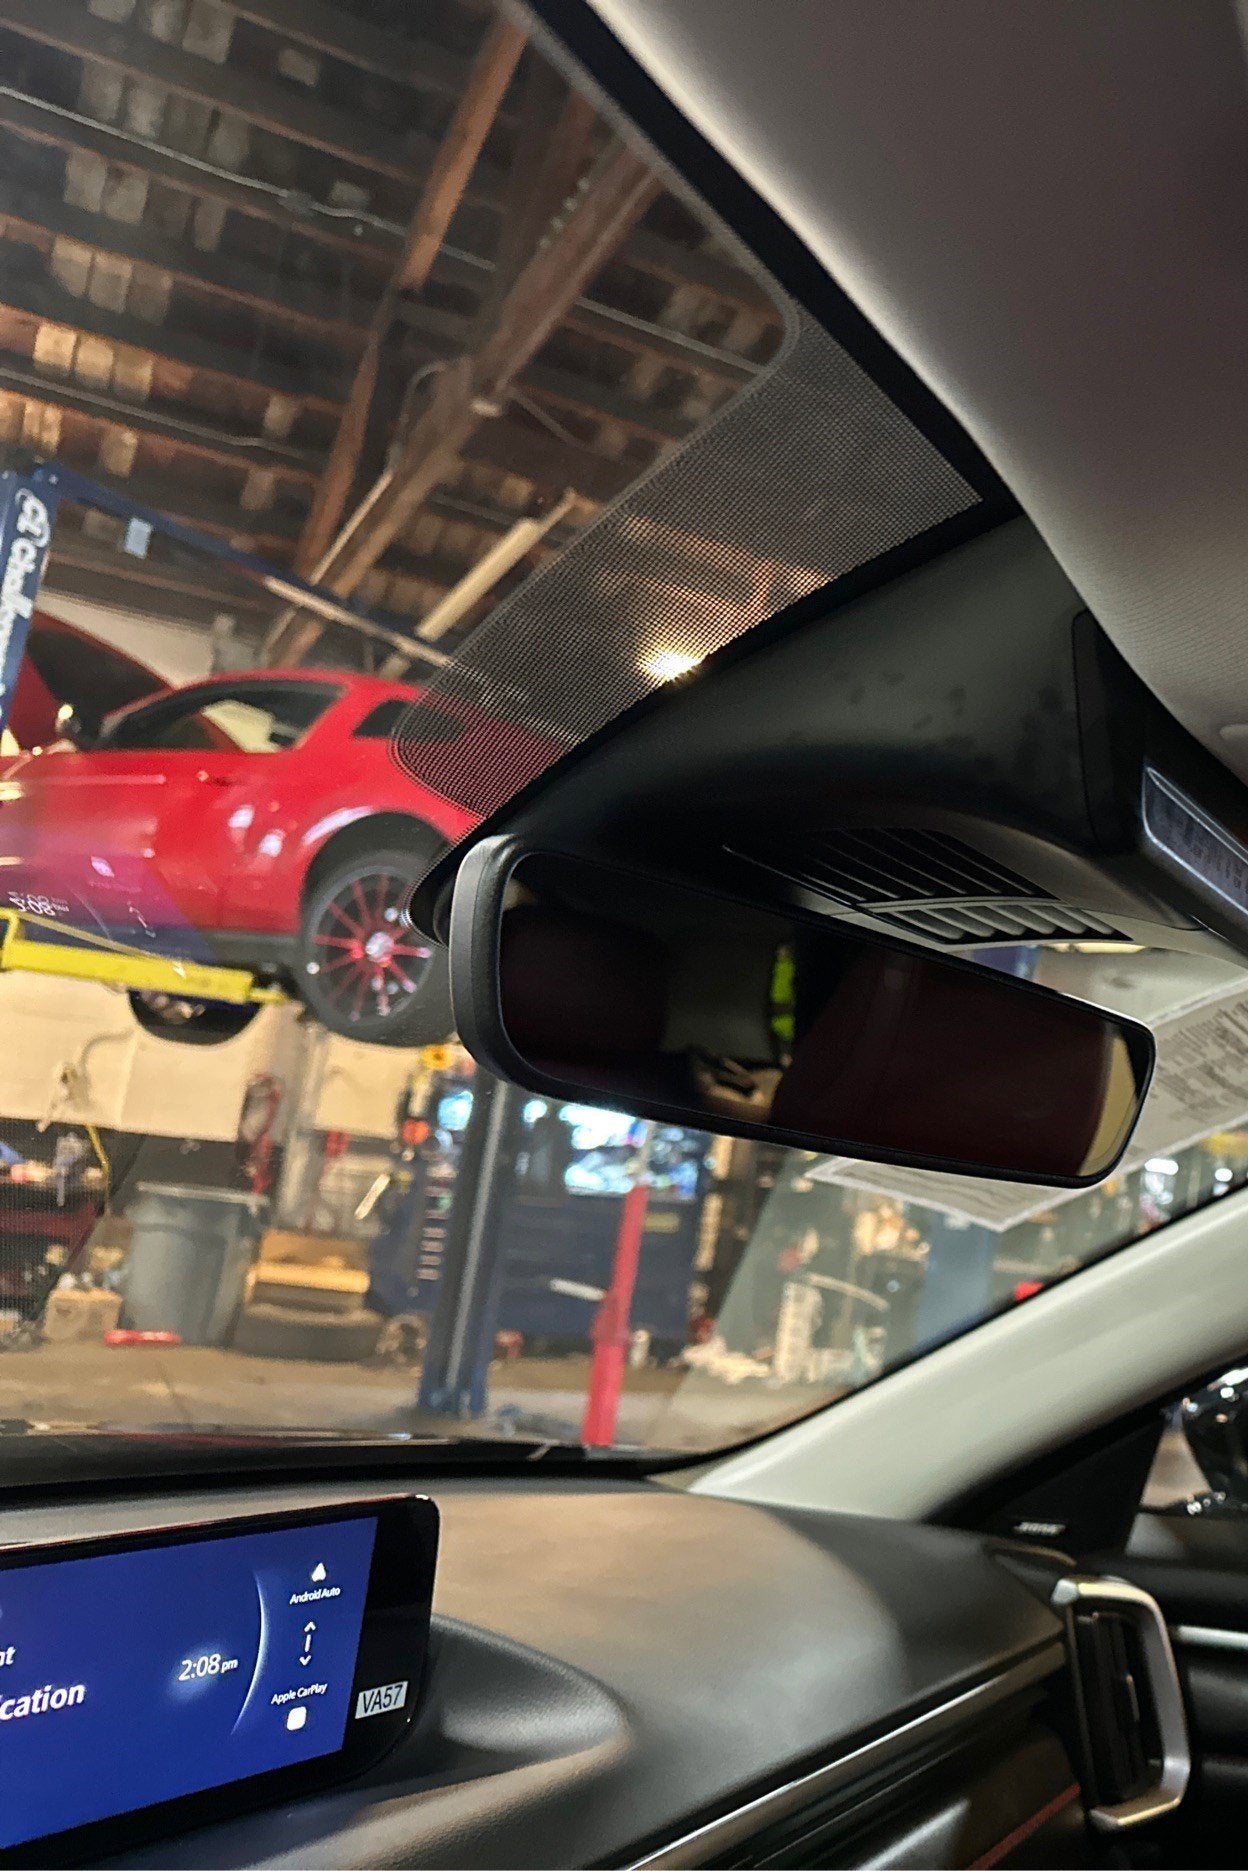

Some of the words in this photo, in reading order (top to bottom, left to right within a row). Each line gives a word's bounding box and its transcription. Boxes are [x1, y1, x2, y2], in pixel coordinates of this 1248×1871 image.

[289, 1590, 322, 1605] Android
[320, 1587, 341, 1599] Auto
[178, 1653, 221, 1681] 2:08
[220, 1659, 239, 1674] pm
[271, 1690, 297, 1705] Apple
[296, 1683, 328, 1698] CarPlay
[362, 1684, 404, 1714] VA57
